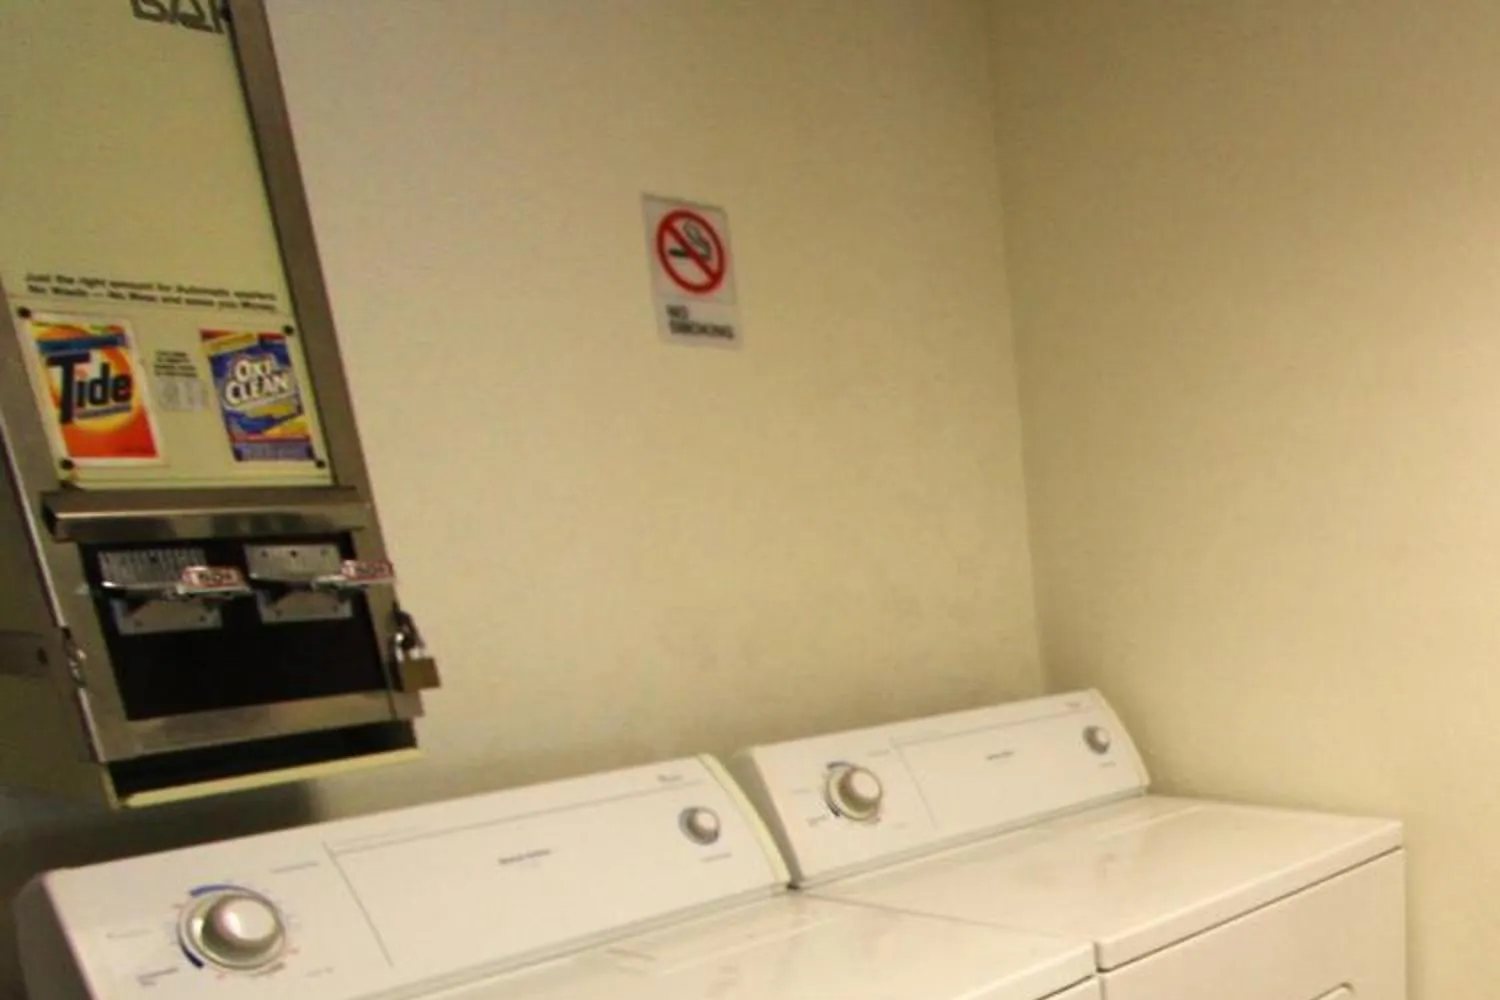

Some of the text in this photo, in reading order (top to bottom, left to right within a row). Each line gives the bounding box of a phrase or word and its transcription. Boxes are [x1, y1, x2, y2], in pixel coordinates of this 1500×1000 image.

[56, 274, 75, 285] the
[79, 277, 106, 290] right
[157, 281, 171, 293] for
[665, 304, 689, 320] NO
[669, 319, 736, 340] SMOKING
[46, 350, 133, 424] Tide
[225, 371, 290, 405] CLEAN
